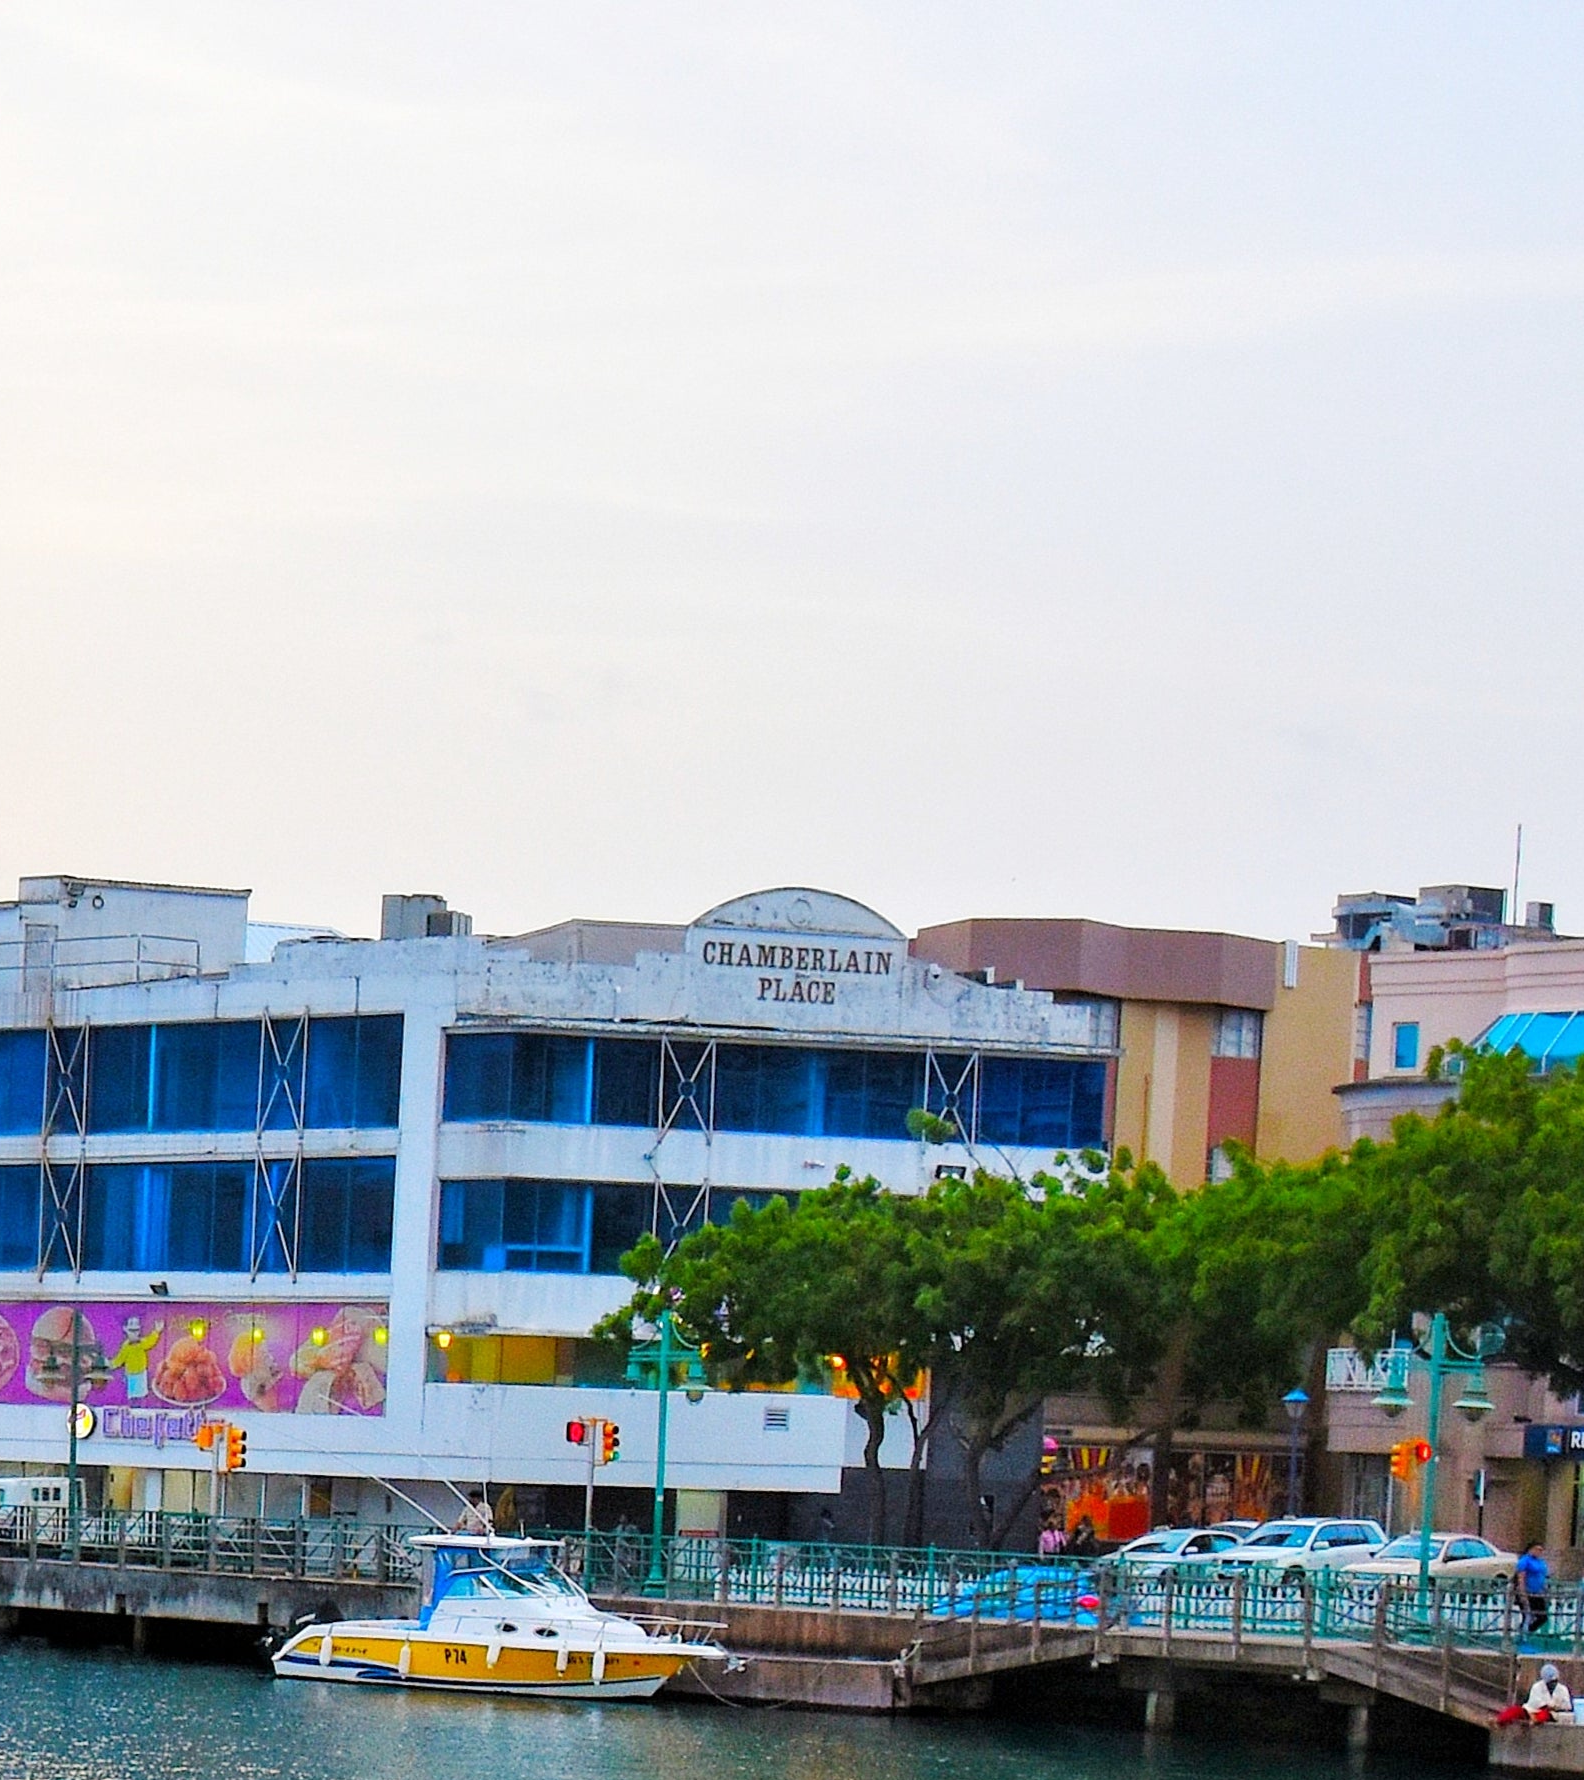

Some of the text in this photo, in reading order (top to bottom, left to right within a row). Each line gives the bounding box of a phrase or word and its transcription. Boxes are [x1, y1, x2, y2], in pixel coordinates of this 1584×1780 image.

[703, 941, 893, 975] CHAMBERLAIN
[757, 977, 836, 1005] PLACE
[103, 1405, 224, 1449] Chefett
